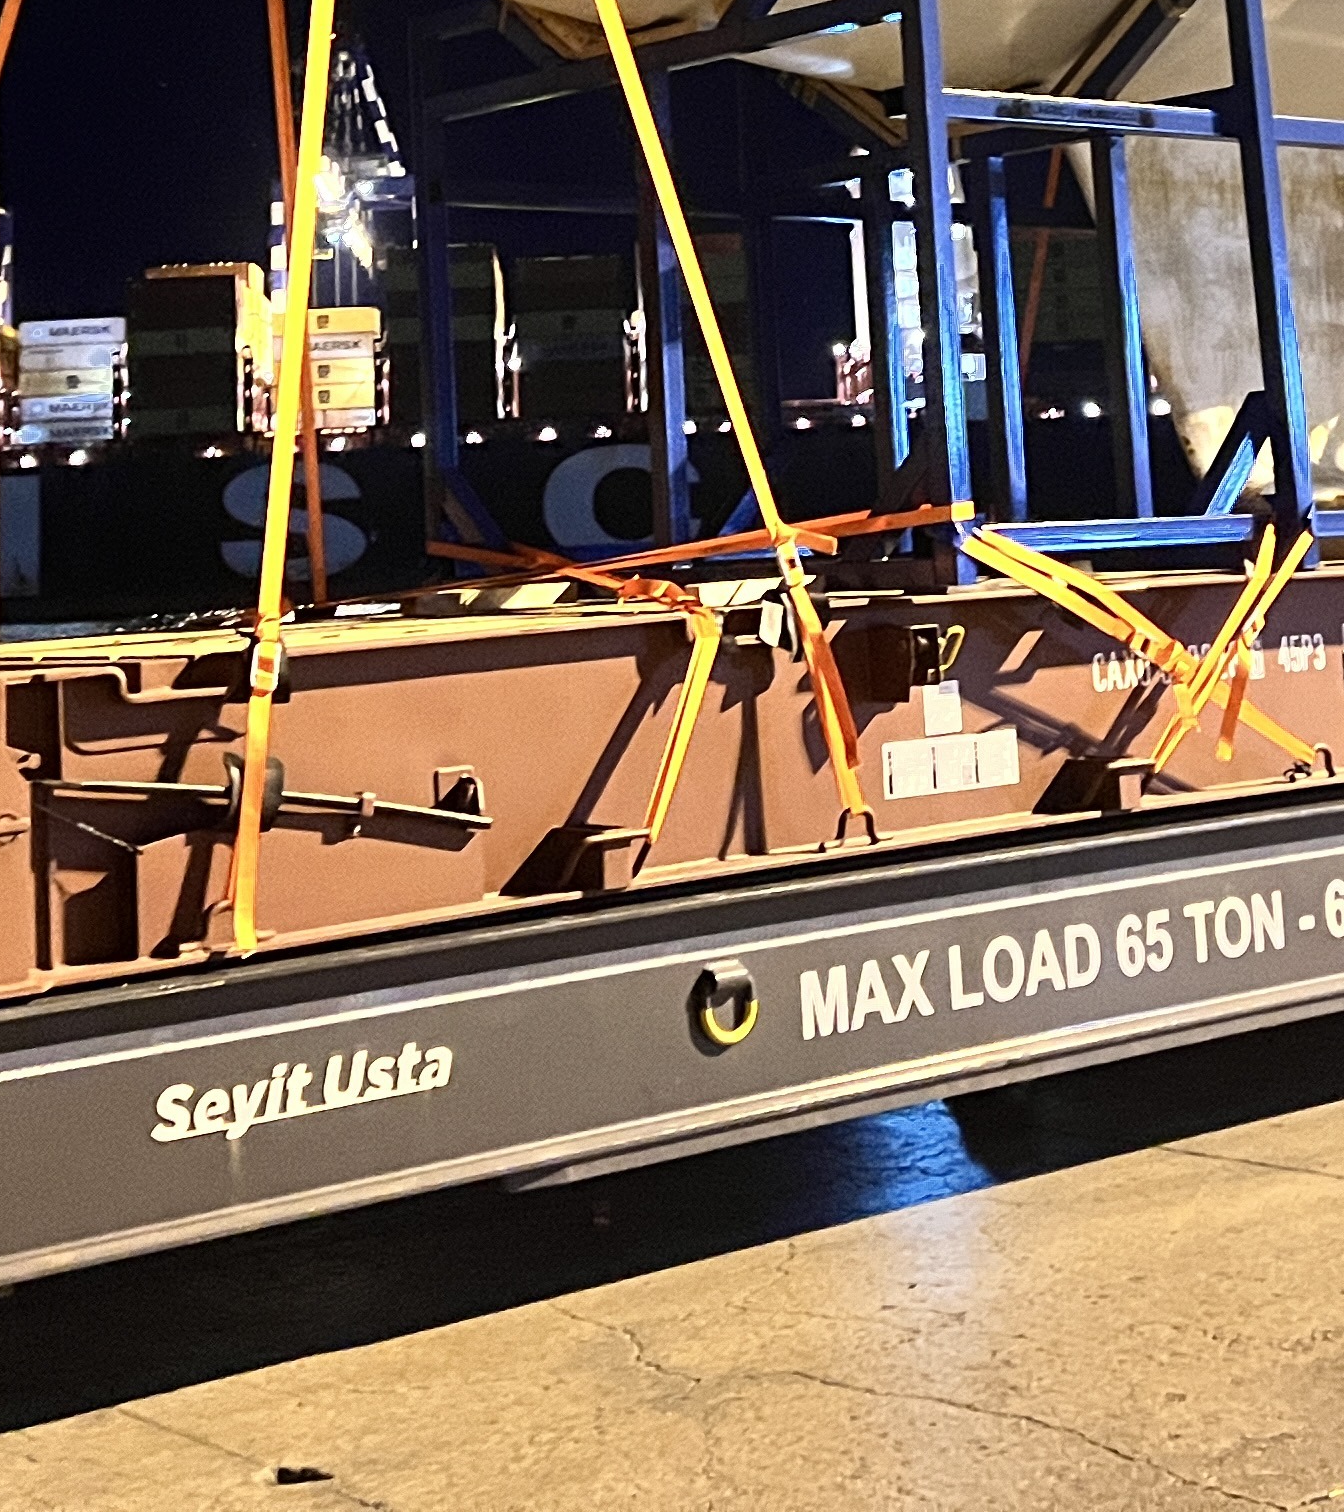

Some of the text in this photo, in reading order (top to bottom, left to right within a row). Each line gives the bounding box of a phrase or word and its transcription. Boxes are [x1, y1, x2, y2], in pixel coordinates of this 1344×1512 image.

[311, 339, 364, 351] AERSK
[1278, 633, 1327, 674] 45P3
[800, 949, 935, 1041] MAX
[948, 923, 1102, 1011] LOAD
[1116, 908, 1174, 979] 65
[1183, 891, 1285, 965] TON
[150, 1041, 453, 1142] Seyit Usta
